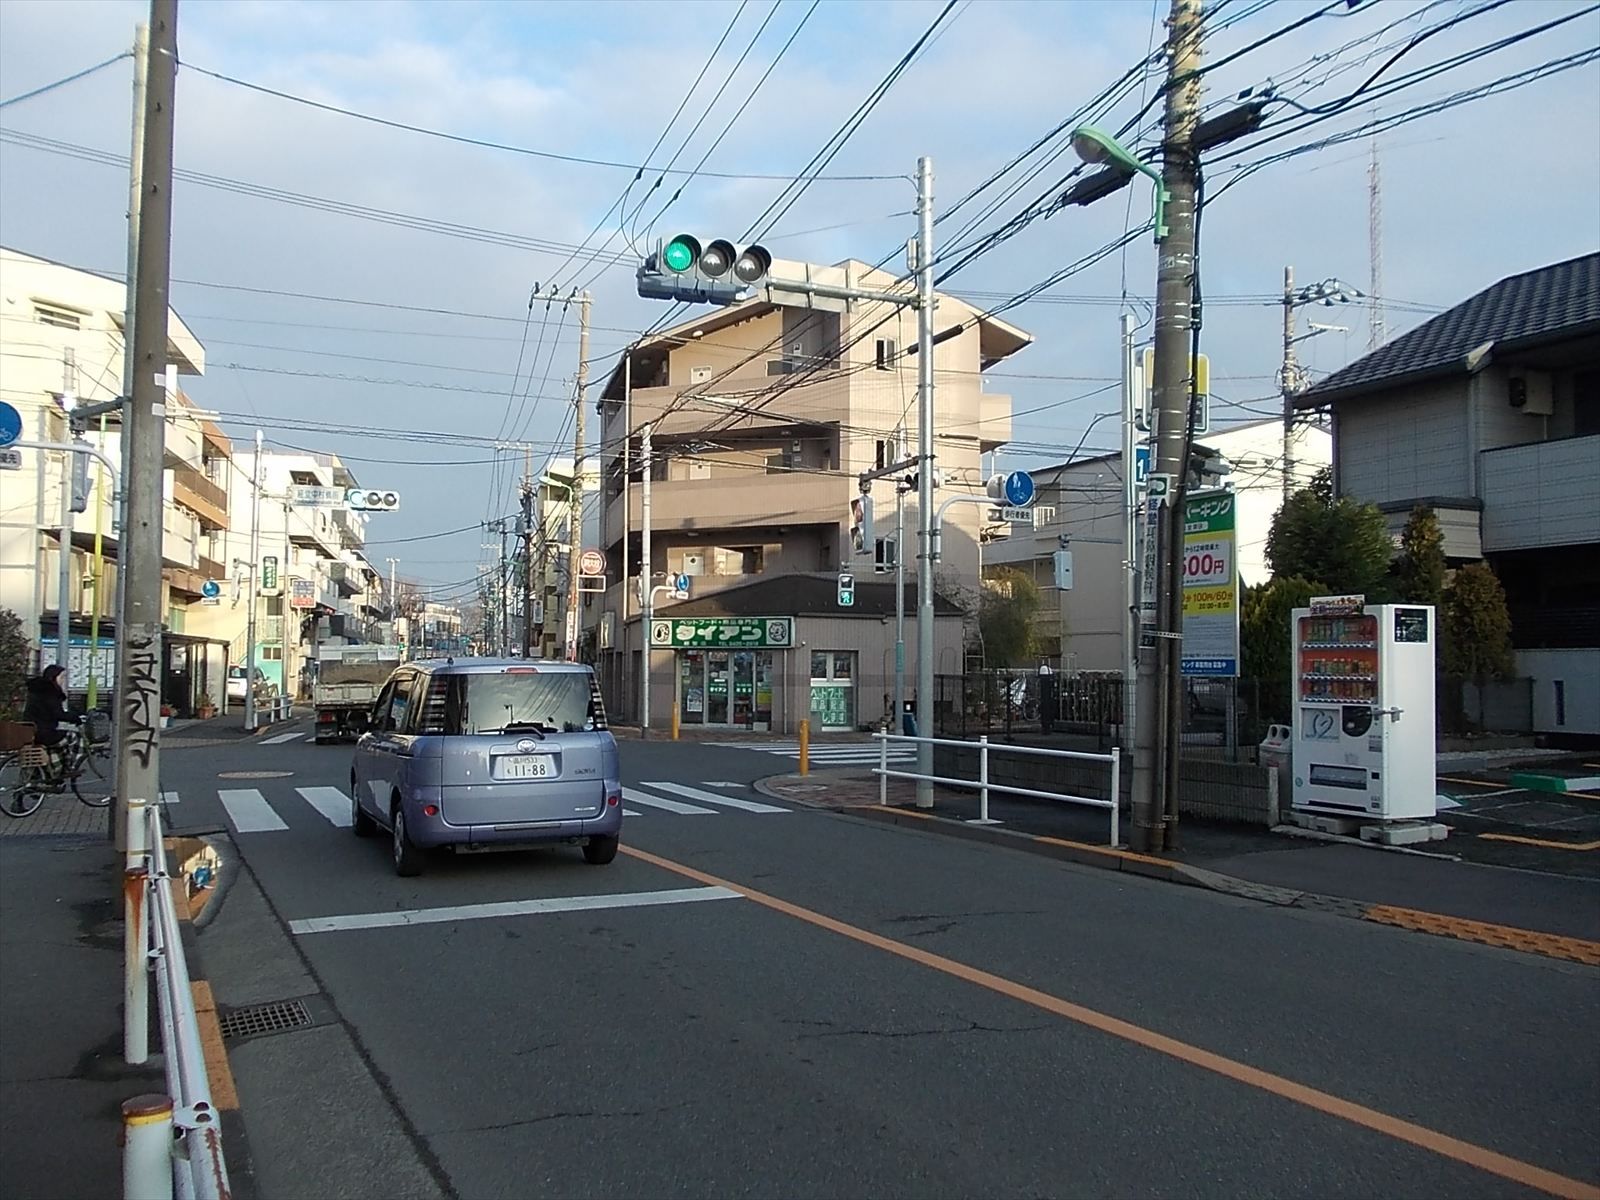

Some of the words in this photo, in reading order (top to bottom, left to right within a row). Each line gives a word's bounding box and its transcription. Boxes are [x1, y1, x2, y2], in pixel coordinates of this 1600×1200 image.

[1005, 510, 1031, 520] 歩行者優先
[515, 764, 546, 777] 11-88
